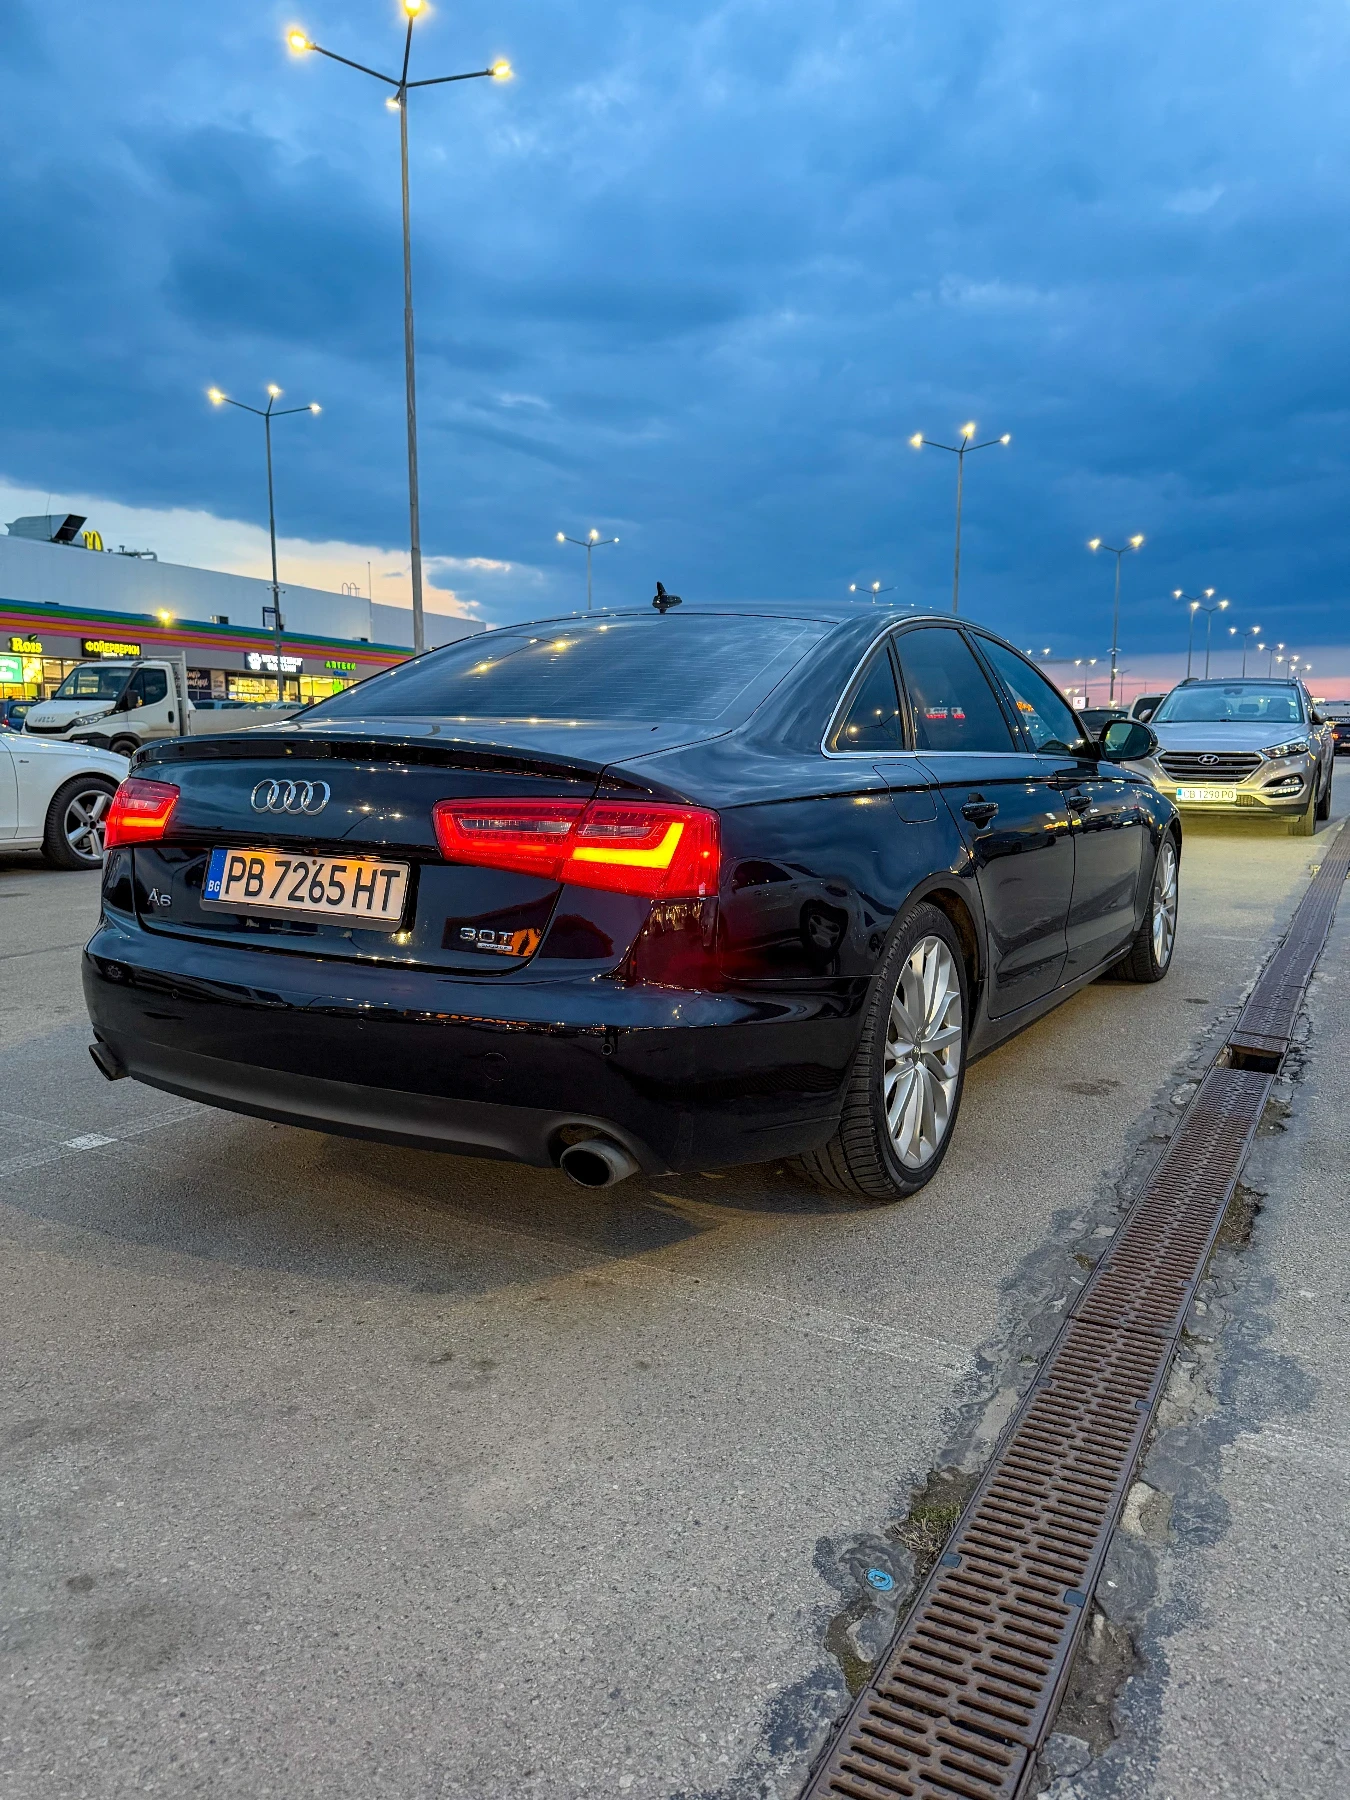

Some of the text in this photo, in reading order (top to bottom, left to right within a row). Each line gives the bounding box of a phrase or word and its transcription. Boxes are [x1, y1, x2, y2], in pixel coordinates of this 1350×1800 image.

[85, 640, 140, 656] ФОЙЕРВЕРКИ
[325, 660, 356, 671] АПТЕКИ
[207, 880, 220, 892] BG
[224, 856, 401, 911] PB 7265 HT
[147, 888, 172, 906] A6
